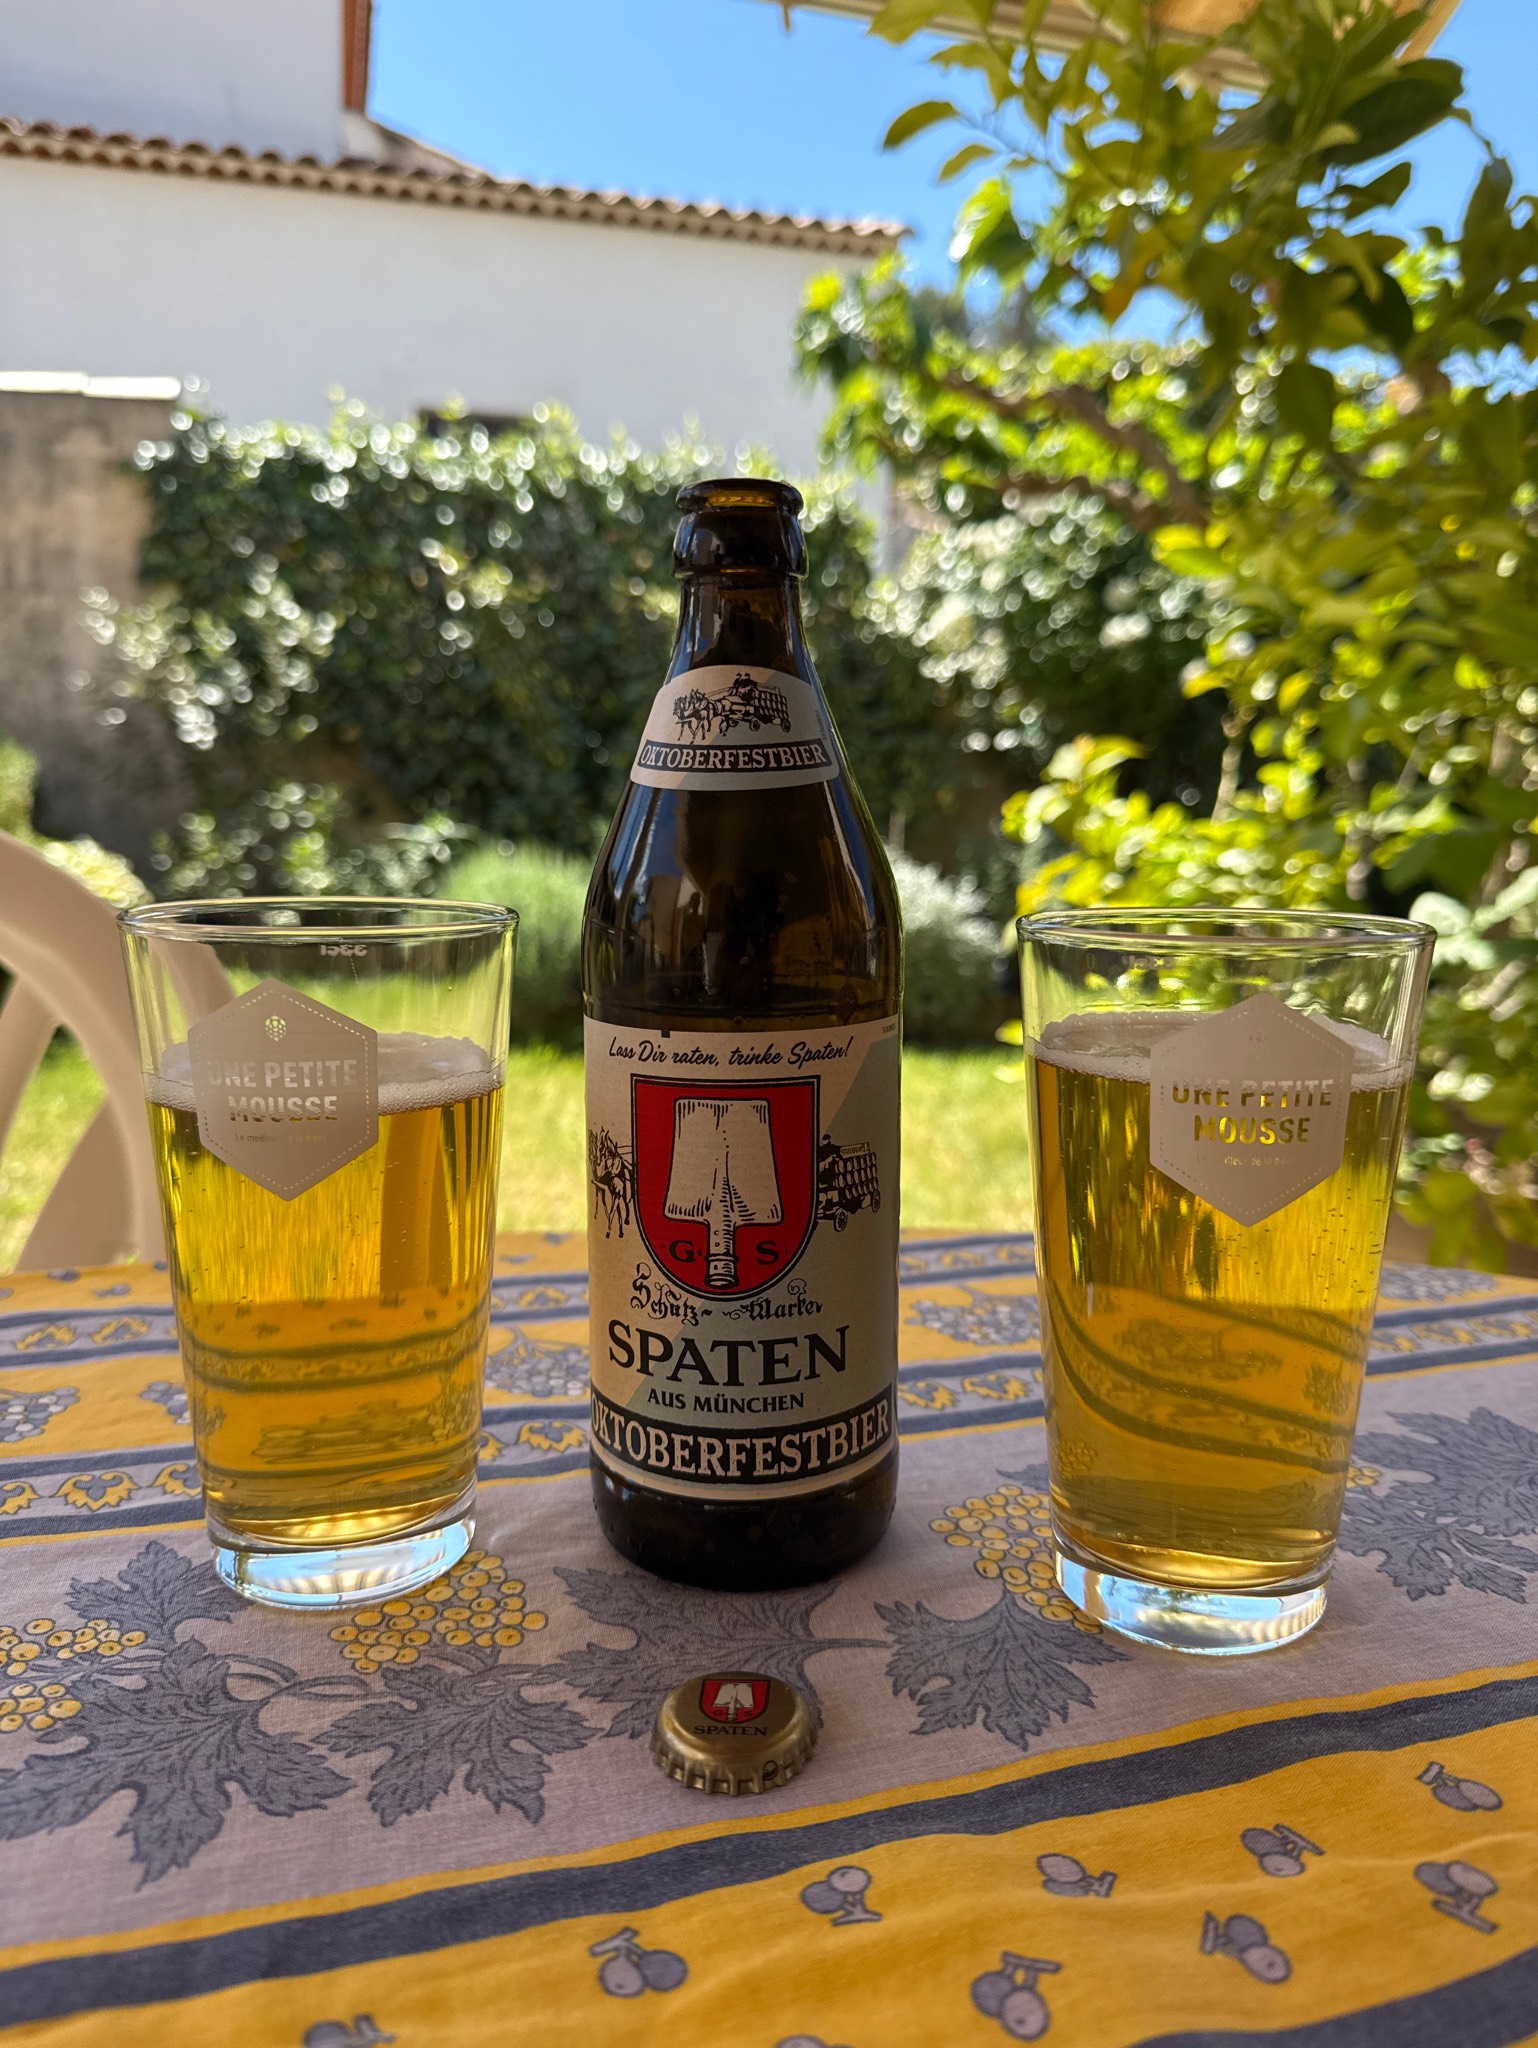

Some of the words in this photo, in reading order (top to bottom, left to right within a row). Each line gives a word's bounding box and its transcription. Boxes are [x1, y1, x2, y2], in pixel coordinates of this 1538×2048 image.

[640, 743, 827, 770] OKTOBERFESTBIER
[609, 1036, 636, 1058] Lass
[638, 1040, 667, 1063] Dir
[671, 1046, 720, 1067] raten,
[728, 1043, 783, 1066] trinke
[787, 1036, 854, 1069] Spaten!
[206, 1060, 256, 1088] UNE
[264, 1059, 358, 1088] PETITE
[1172, 1079, 1231, 1107] UNE
[1240, 1078, 1334, 1108] PETITE
[228, 1095, 338, 1123] MOUSSE
[1194, 1115, 1311, 1145] MOUSSE
[669, 1239, 696, 1263] G
[756, 1240, 780, 1265] S
[608, 1318, 850, 1387] SPATEN
[647, 1387, 686, 1409] AUS
[693, 1391, 805, 1414] MÜNCHEN
[591, 1391, 889, 1478] OKTOBERFESTBIER
[694, 1725, 768, 1736] SPATEN
